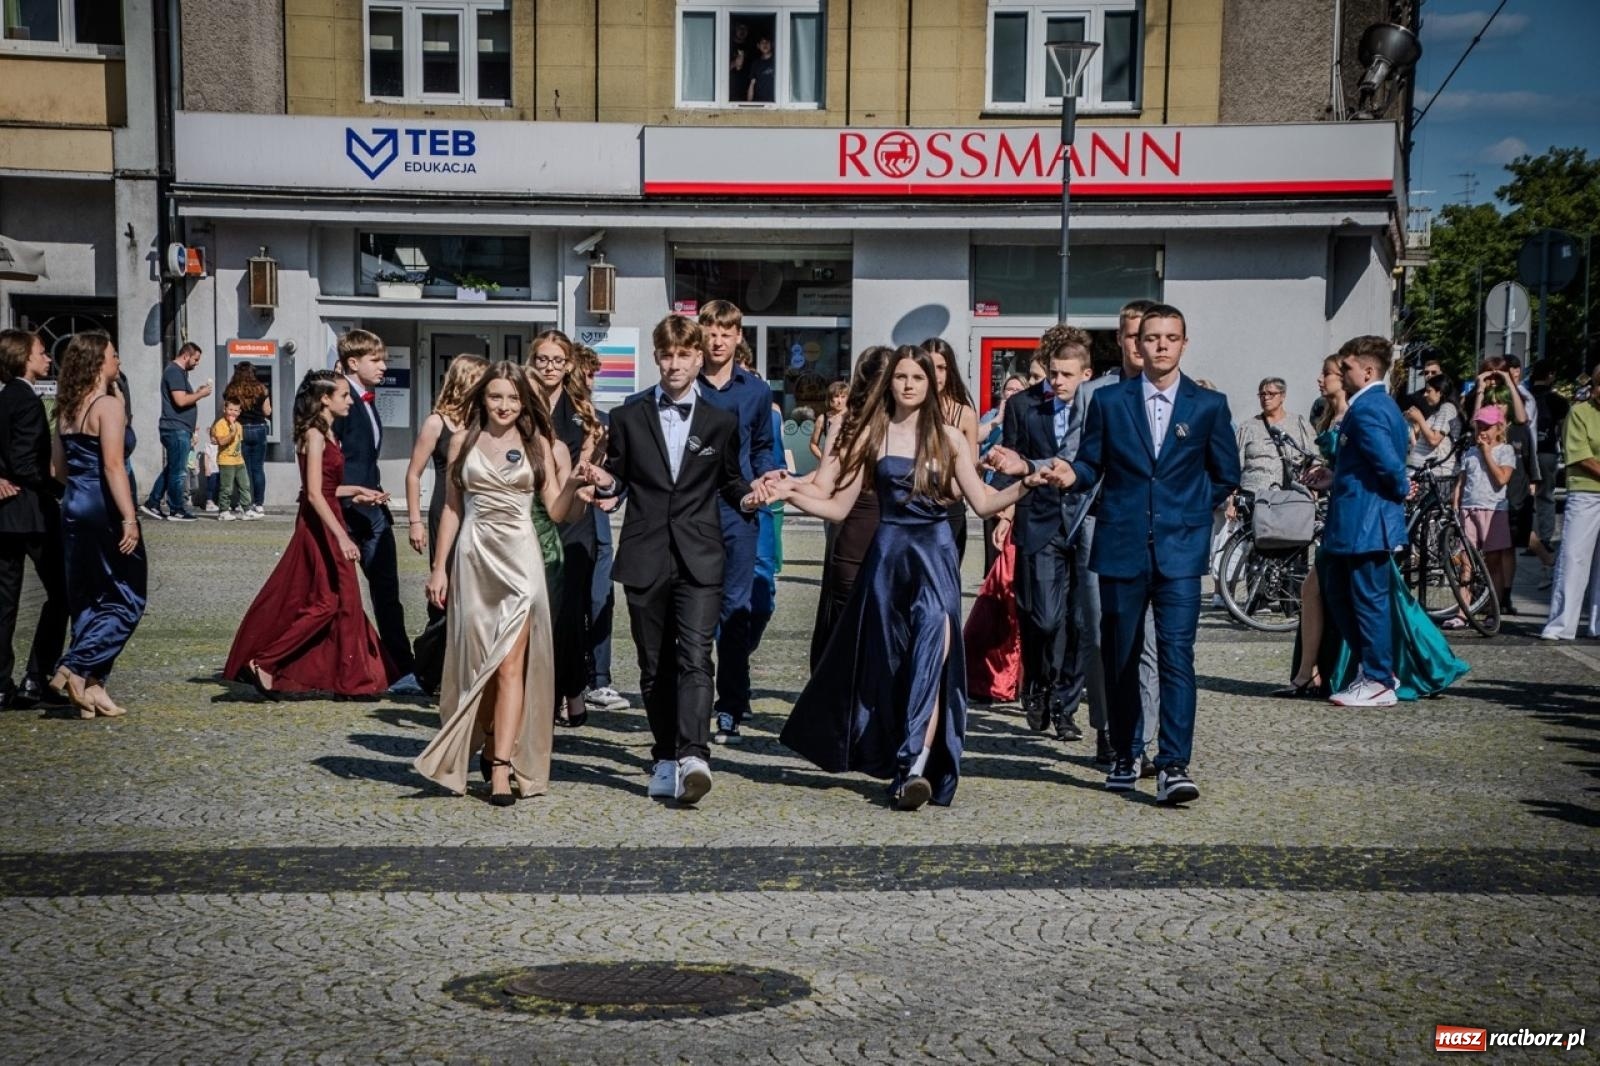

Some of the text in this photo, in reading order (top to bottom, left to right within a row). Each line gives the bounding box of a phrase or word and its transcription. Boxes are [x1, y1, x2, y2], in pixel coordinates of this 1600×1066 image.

[405, 128, 476, 156] TEB
[839, 130, 1182, 178] ROSSMANN
[404, 161, 476, 173] EDUKACJA
[235, 343, 270, 351] bankomat
